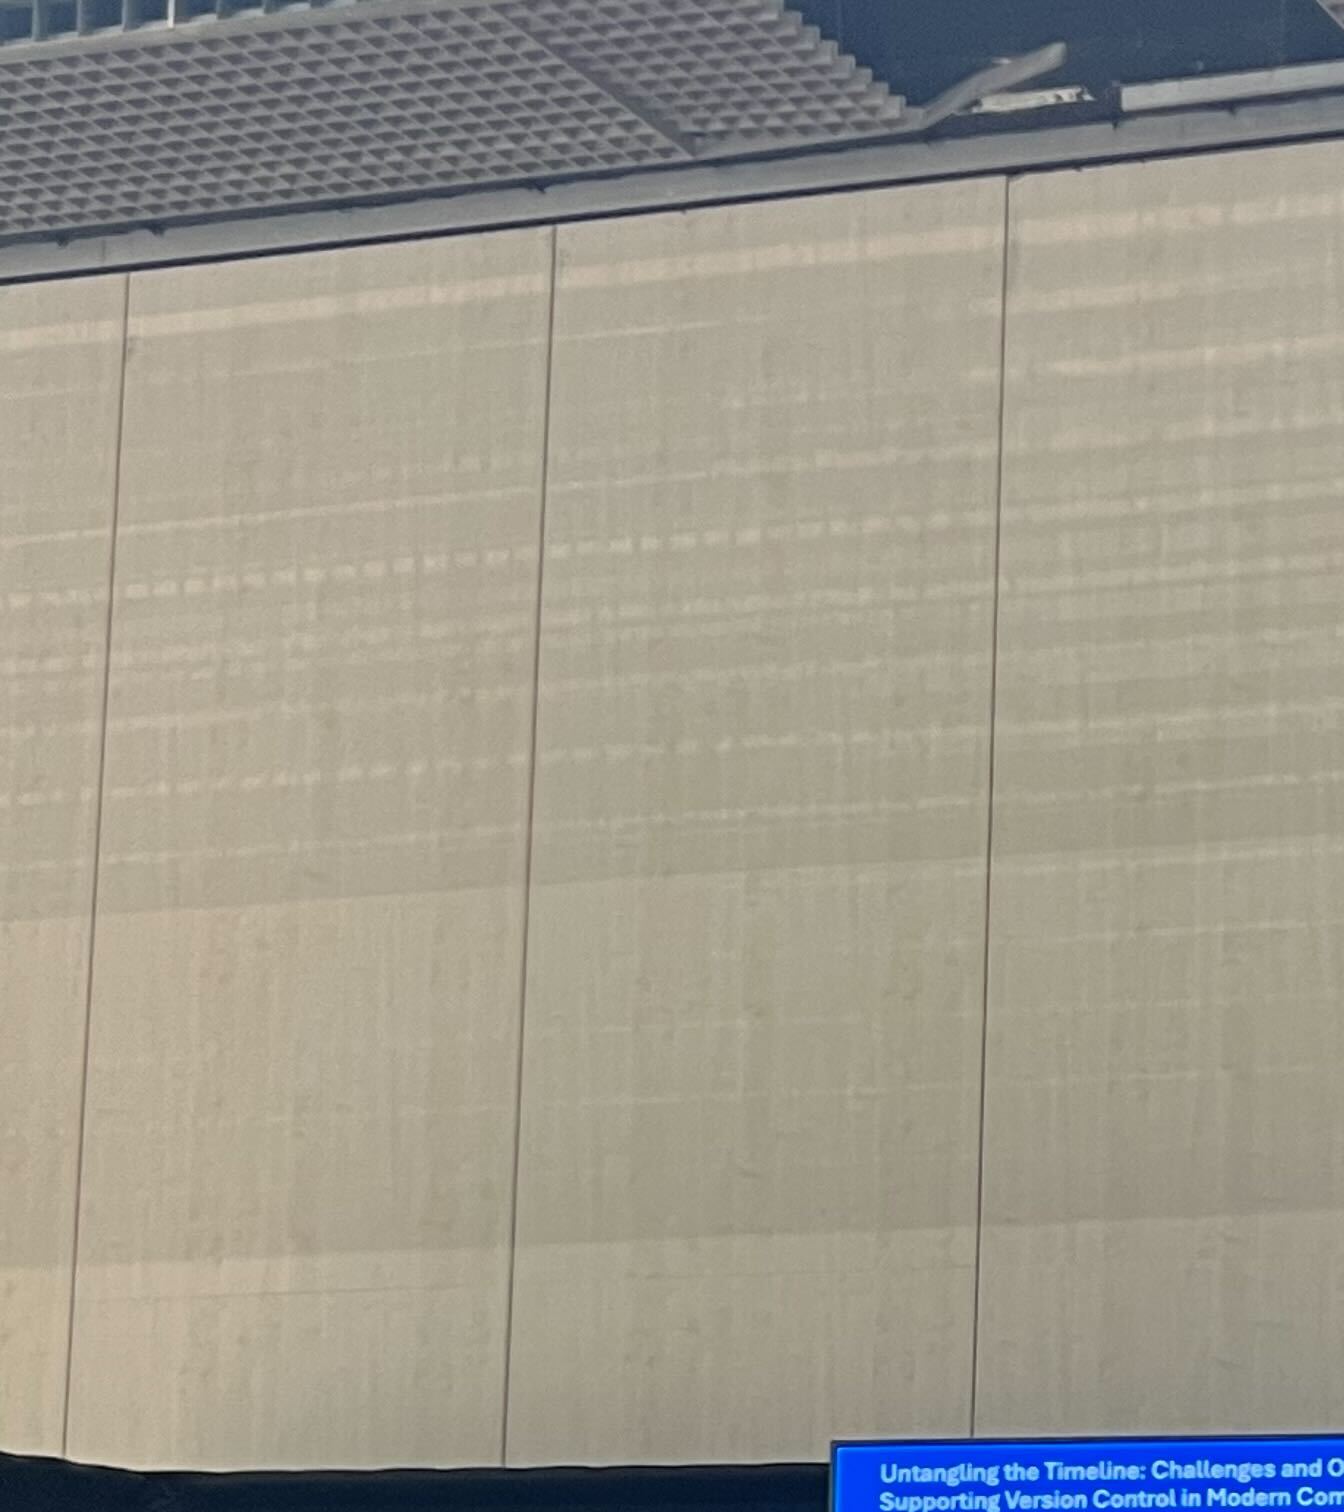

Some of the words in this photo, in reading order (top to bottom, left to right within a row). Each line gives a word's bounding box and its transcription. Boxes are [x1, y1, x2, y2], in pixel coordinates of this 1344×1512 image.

[880, 1463, 1000, 1487] Untangling
[1003, 1462, 1039, 1481] the
[1044, 1461, 1146, 1481] Timeline:
[1151, 1459, 1276, 1483] Challenges
[1281, 1458, 1322, 1478] and
[1005, 1489, 1087, 1509] Version
[1093, 1488, 1175, 1508] Control
[1181, 1488, 1200, 1507] in
[1207, 1487, 1291, 1507] Modern
